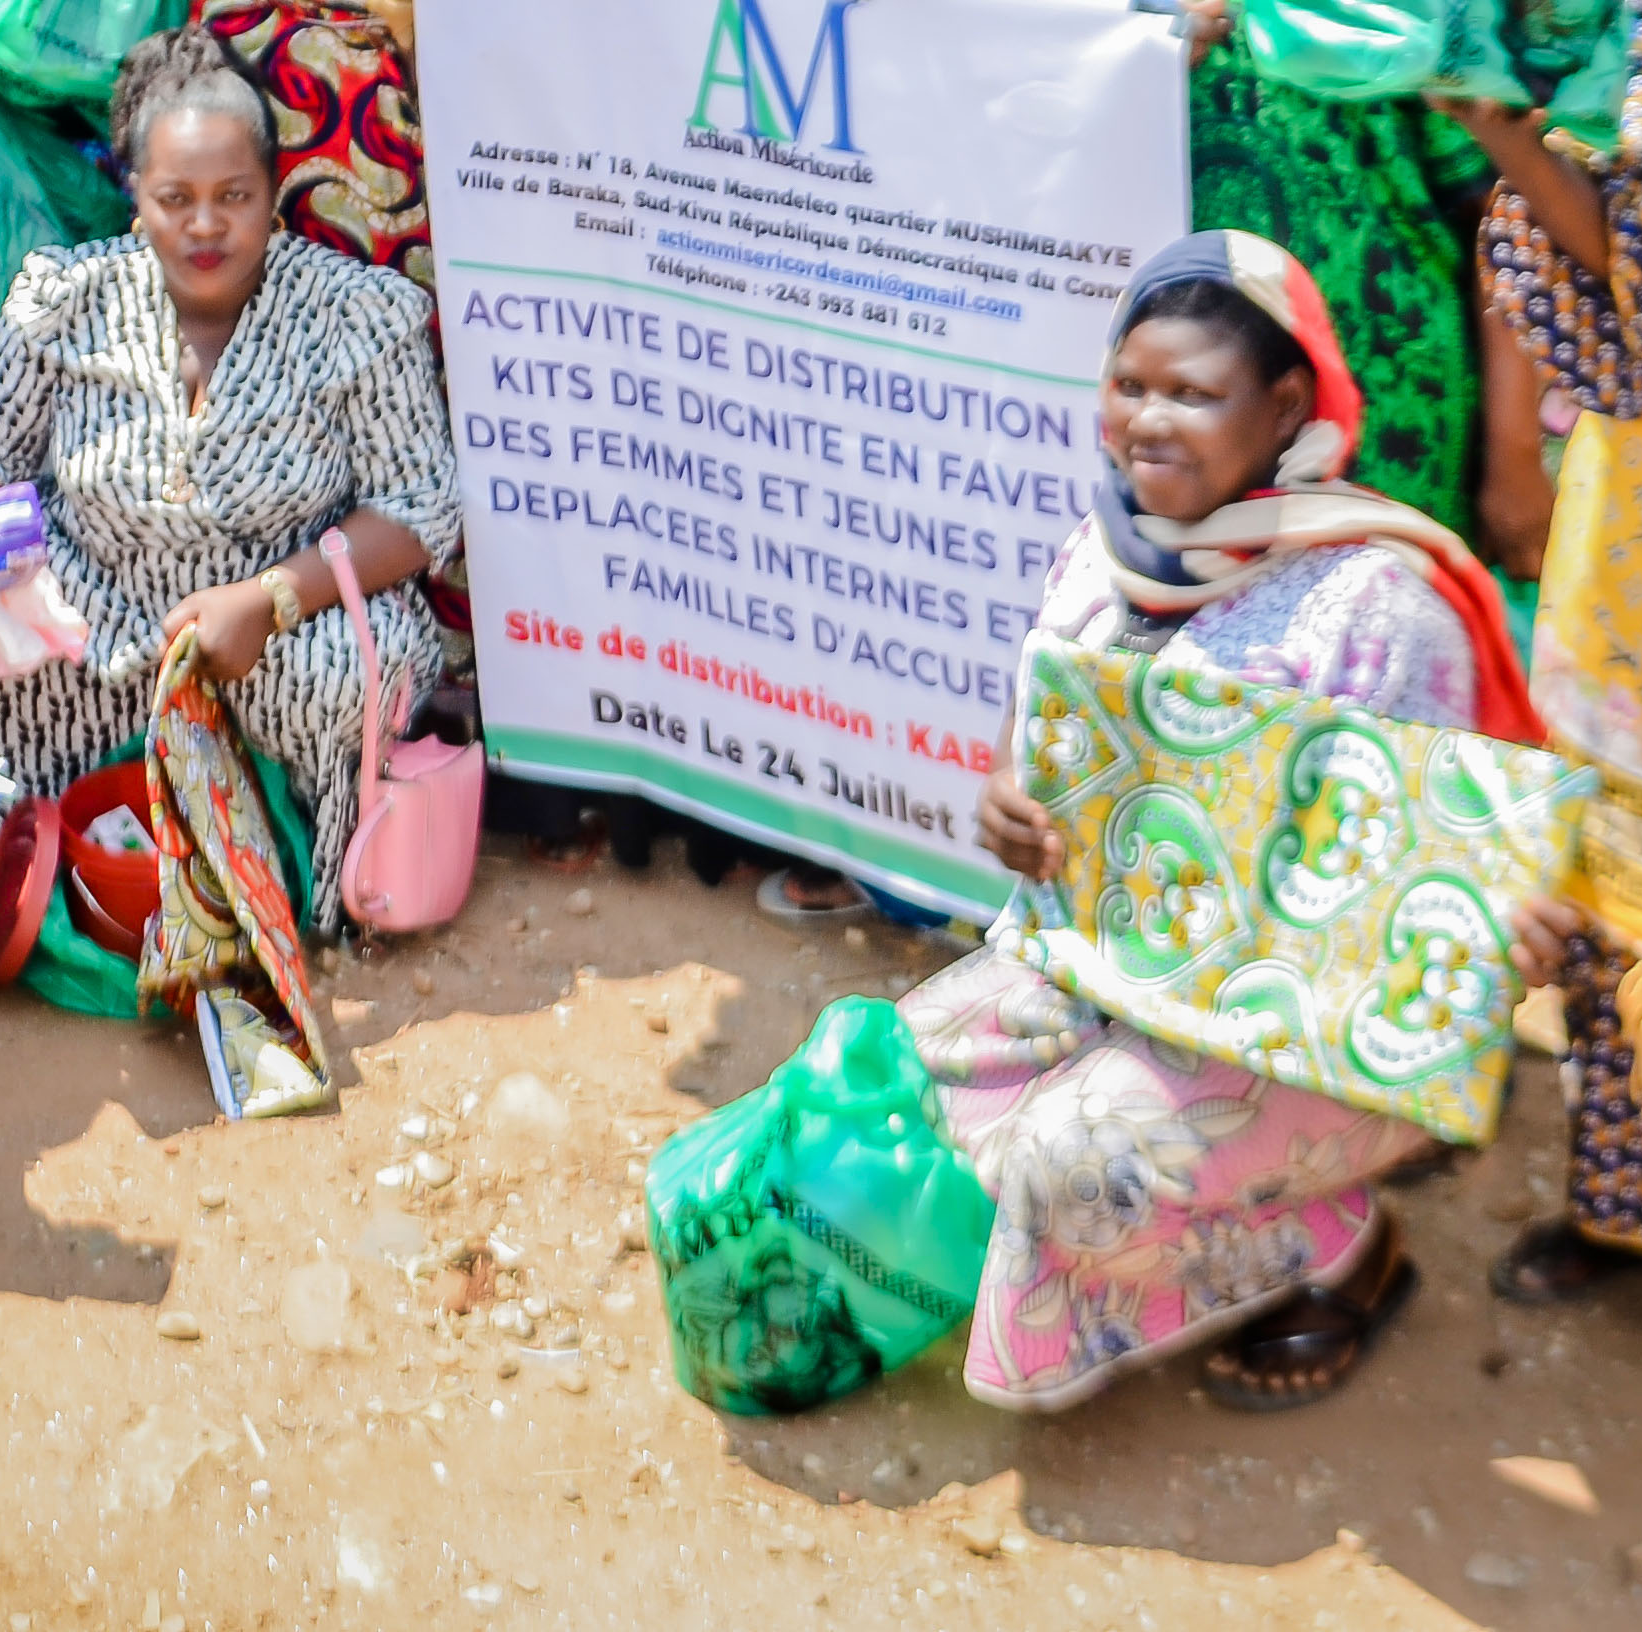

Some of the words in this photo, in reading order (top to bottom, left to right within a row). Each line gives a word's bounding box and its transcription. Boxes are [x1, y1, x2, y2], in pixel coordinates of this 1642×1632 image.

[457, 169, 505, 191] Ville
[513, 174, 540, 194] de
[548, 177, 626, 207] Baraka,
[634, 189, 722, 226] Sud-Kivu
[730, 210, 849, 251] République
[857, 235, 1019, 283] Démocratique
[1026, 268, 1055, 291] du
[470, 140, 560, 166] Adresse
[644, 162, 717, 193] Avenue
[724, 177, 838, 216] Maendeleo
[846, 202, 938, 235] quartier
[944, 218, 1133, 268] MUSHIMBAKYE
[683, 124, 745, 156] Action
[751, 138, 874, 184] Miséricorde
[575, 211, 634, 237] Email
[657, 228, 1022, 321] actionmisericordeami@gmail.com
[647, 253, 747, 293] Téléphone
[765, 282, 811, 308] +243
[908, 310, 947, 336] 612
[462, 288, 662, 353] ACTIVITE
[676, 320, 730, 369] DE
[745, 337, 1071, 448] DISTRIBUTION
[492, 354, 594, 400] KITS
[611, 369, 663, 417] DE
[678, 385, 844, 465] DIGNITE
[860, 433, 920, 484] EN
[938, 451, 1100, 519] FAVEU
[465, 411, 552, 458] DES
[570, 424, 744, 501] FEMMES
[758, 471, 810, 518] ET
[822, 488, 997, 569] JEUNES
[489, 476, 738, 561] DEPLACEES
[753, 532, 969, 629] INTERNES
[986, 597, 1041, 644] ET
[505, 609, 584, 651] Site
[597, 623, 647, 661] de
[658, 639, 874, 740] distribution
[907, 718, 994, 775] KAB
[603, 553, 795, 642] FAMILLES
[812, 612, 1014, 707] D'ACCUEI
[589, 687, 688, 745] Date
[700, 717, 744, 765] Le
[756, 738, 806, 786] 24
[819, 756, 955, 841] Juillet
